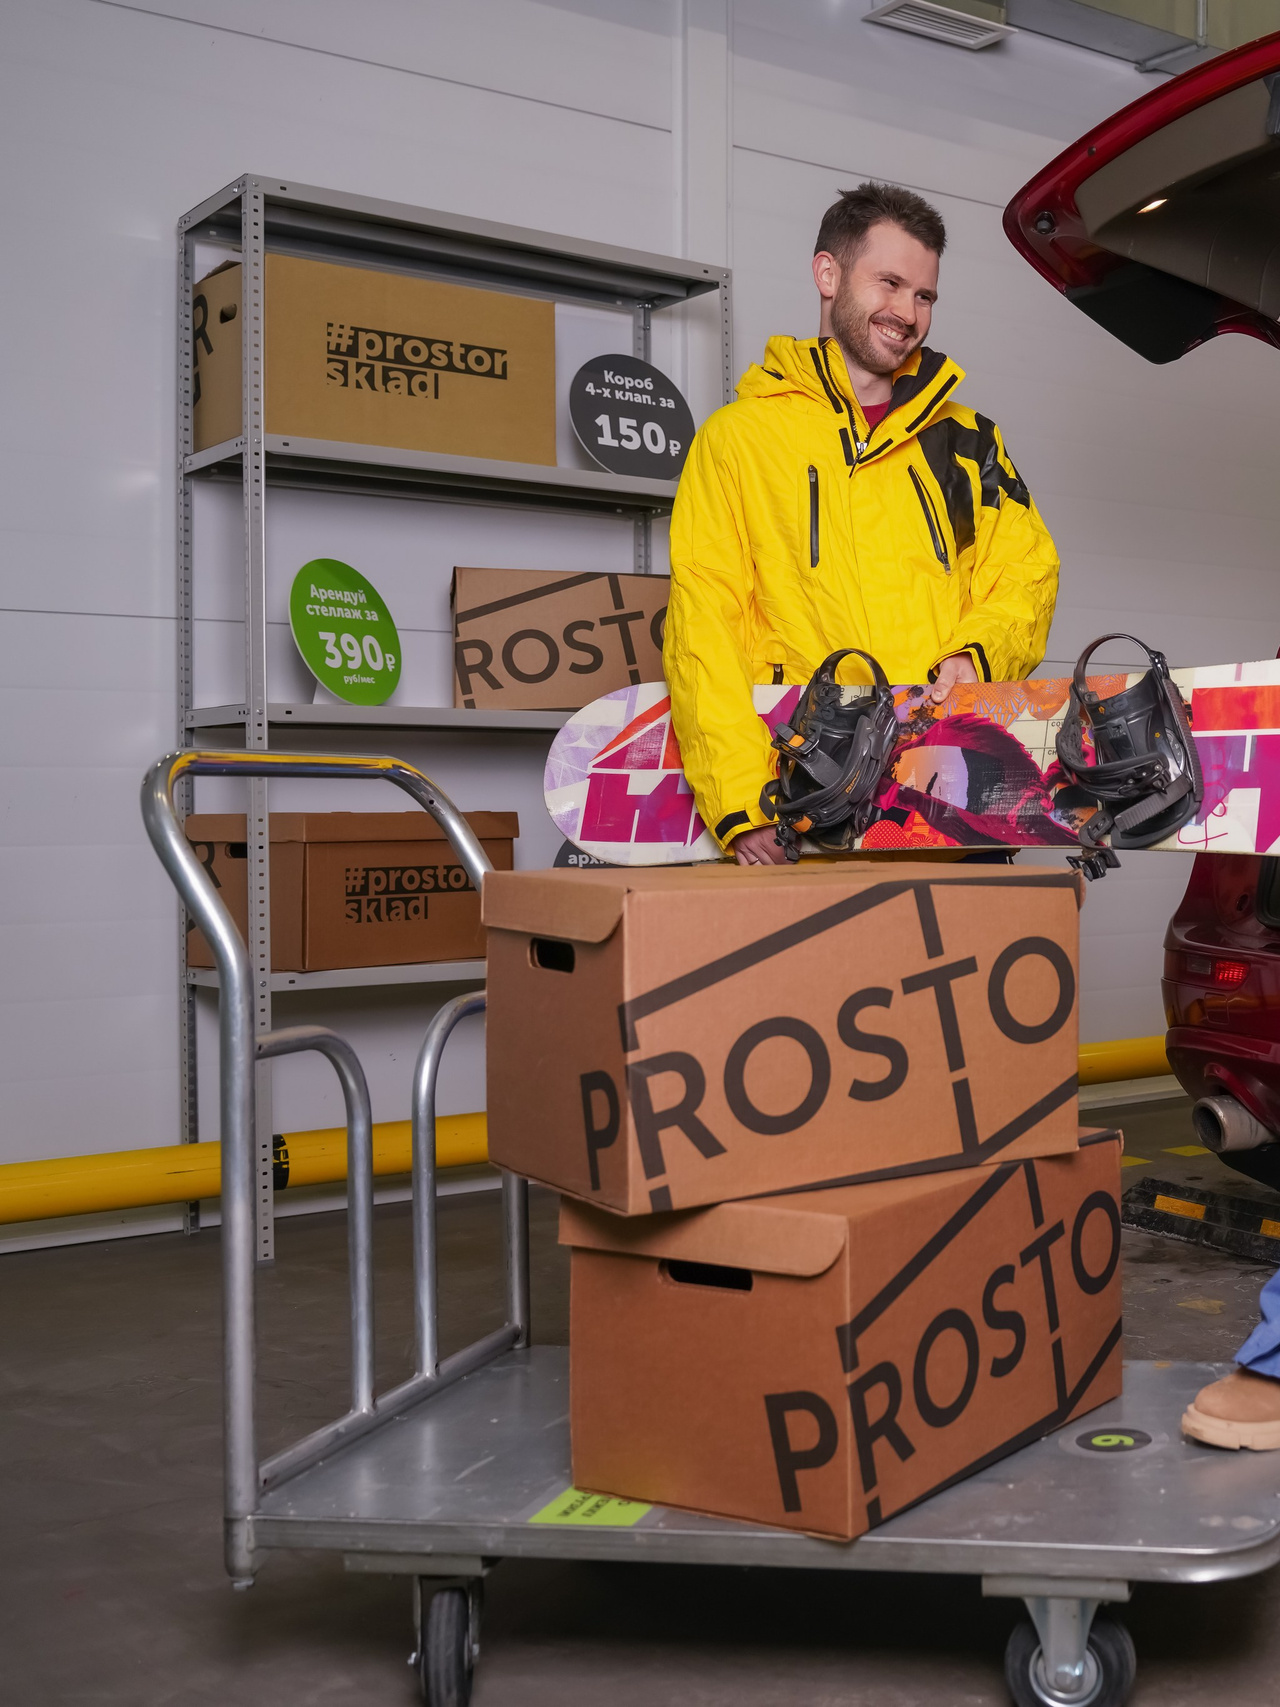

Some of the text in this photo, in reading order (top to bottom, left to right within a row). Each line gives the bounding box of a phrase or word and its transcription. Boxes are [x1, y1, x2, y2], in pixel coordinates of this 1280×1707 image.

[326, 322, 508, 378] #prostor
[326, 358, 438, 399] sklad
[603, 370, 654, 390] Короб
[585, 382, 676, 409] 4-х клап. за
[310, 583, 368, 606] Арендуй
[305, 604, 379, 621] стеллаж за
[343, 674, 376, 684] руб/мес
[345, 897, 428, 922] sklad
[579, 936, 1075, 1191] PROSTO
[763, 1190, 1121, 1512] PROSTO
